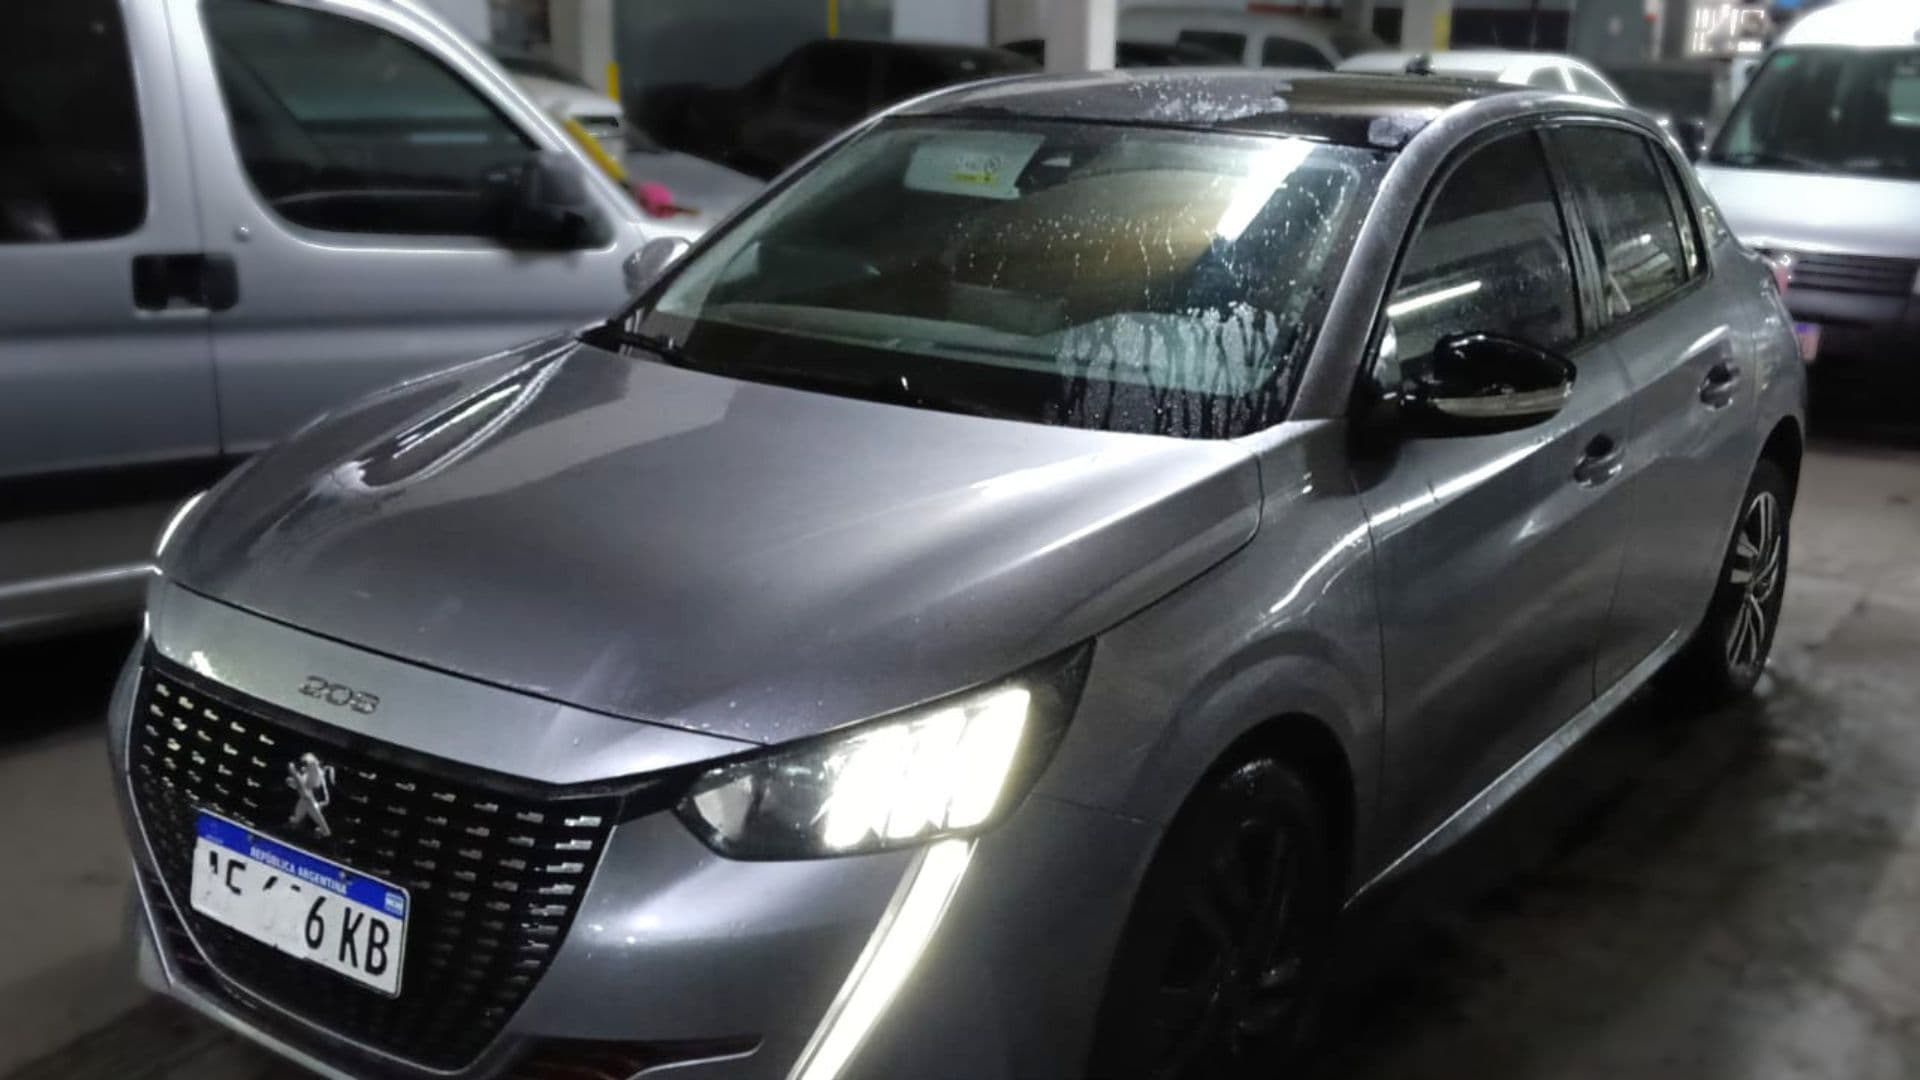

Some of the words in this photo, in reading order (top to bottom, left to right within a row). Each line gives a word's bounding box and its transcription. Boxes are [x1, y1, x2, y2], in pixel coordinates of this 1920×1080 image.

[298, 676, 380, 714] 208
[297, 866, 347, 895] ARGENTINA
[338, 905, 390, 977] KB
